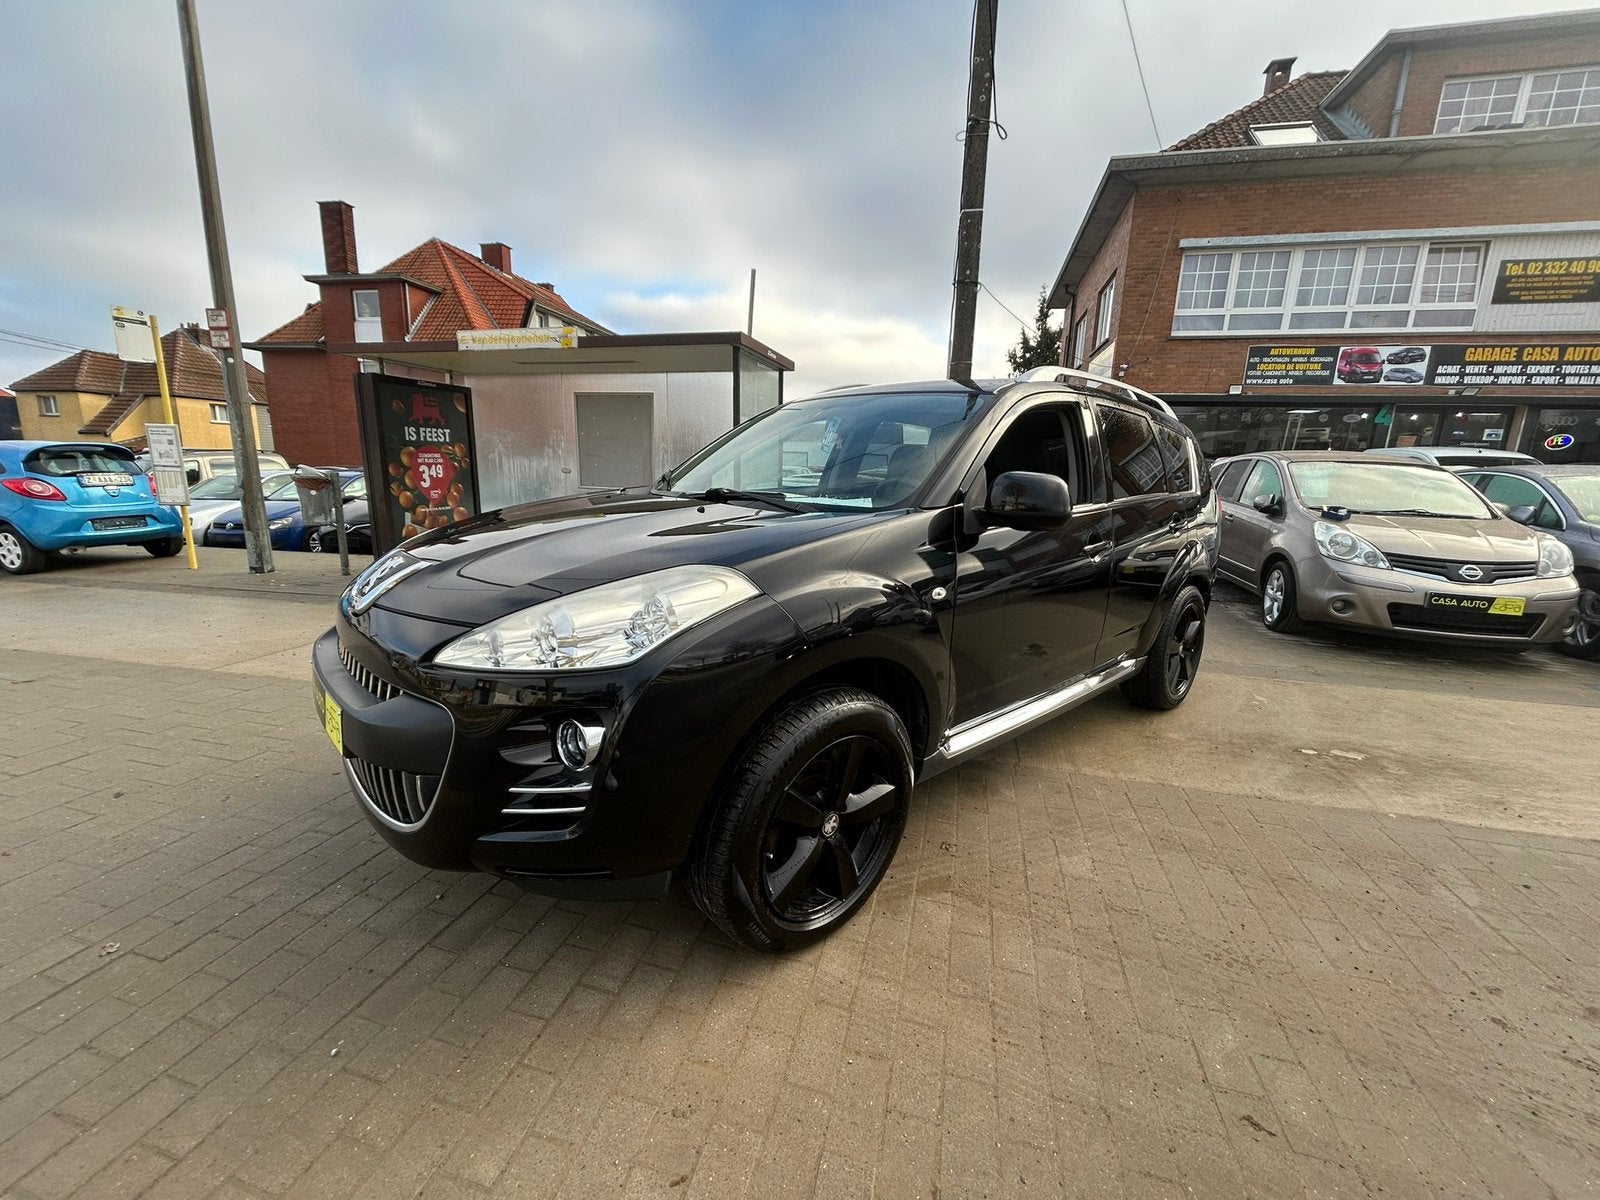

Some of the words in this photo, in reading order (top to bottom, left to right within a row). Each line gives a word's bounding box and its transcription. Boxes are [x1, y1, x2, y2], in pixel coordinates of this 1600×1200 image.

[1506, 262, 1525, 275] Tel.
[1527, 261, 1543, 274] 02
[1544, 261, 1568, 274] 332
[1569, 260, 1586, 273] 40
[1270, 347, 1316, 355] AUTOVERHUUR
[1465, 347, 1519, 361] GARAGE
[1522, 346, 1559, 361] CASA
[1563, 346, 1600, 361] AUTO
[1436, 365, 1461, 373] ACHAT
[1465, 365, 1488, 373] VENTE
[1492, 365, 1523, 373] IMPORT
[1526, 365, 1555, 373] EXPORT
[1561, 365, 1590, 373] TOUTES
[1434, 376, 1460, 384] INKOOP
[1463, 376, 1494, 384] VERKOOP
[1497, 376, 1527, 384] IMPORT
[1531, 376, 1561, 384] EXPORT
[1564, 376, 1580, 385] VAN
[1579, 376, 1596, 385] ALLE
[404, 426, 417, 441] IS
[419, 427, 451, 442] FEEST
[1431, 597, 1457, 606] CASA
[1460, 600, 1489, 609] AUTO
